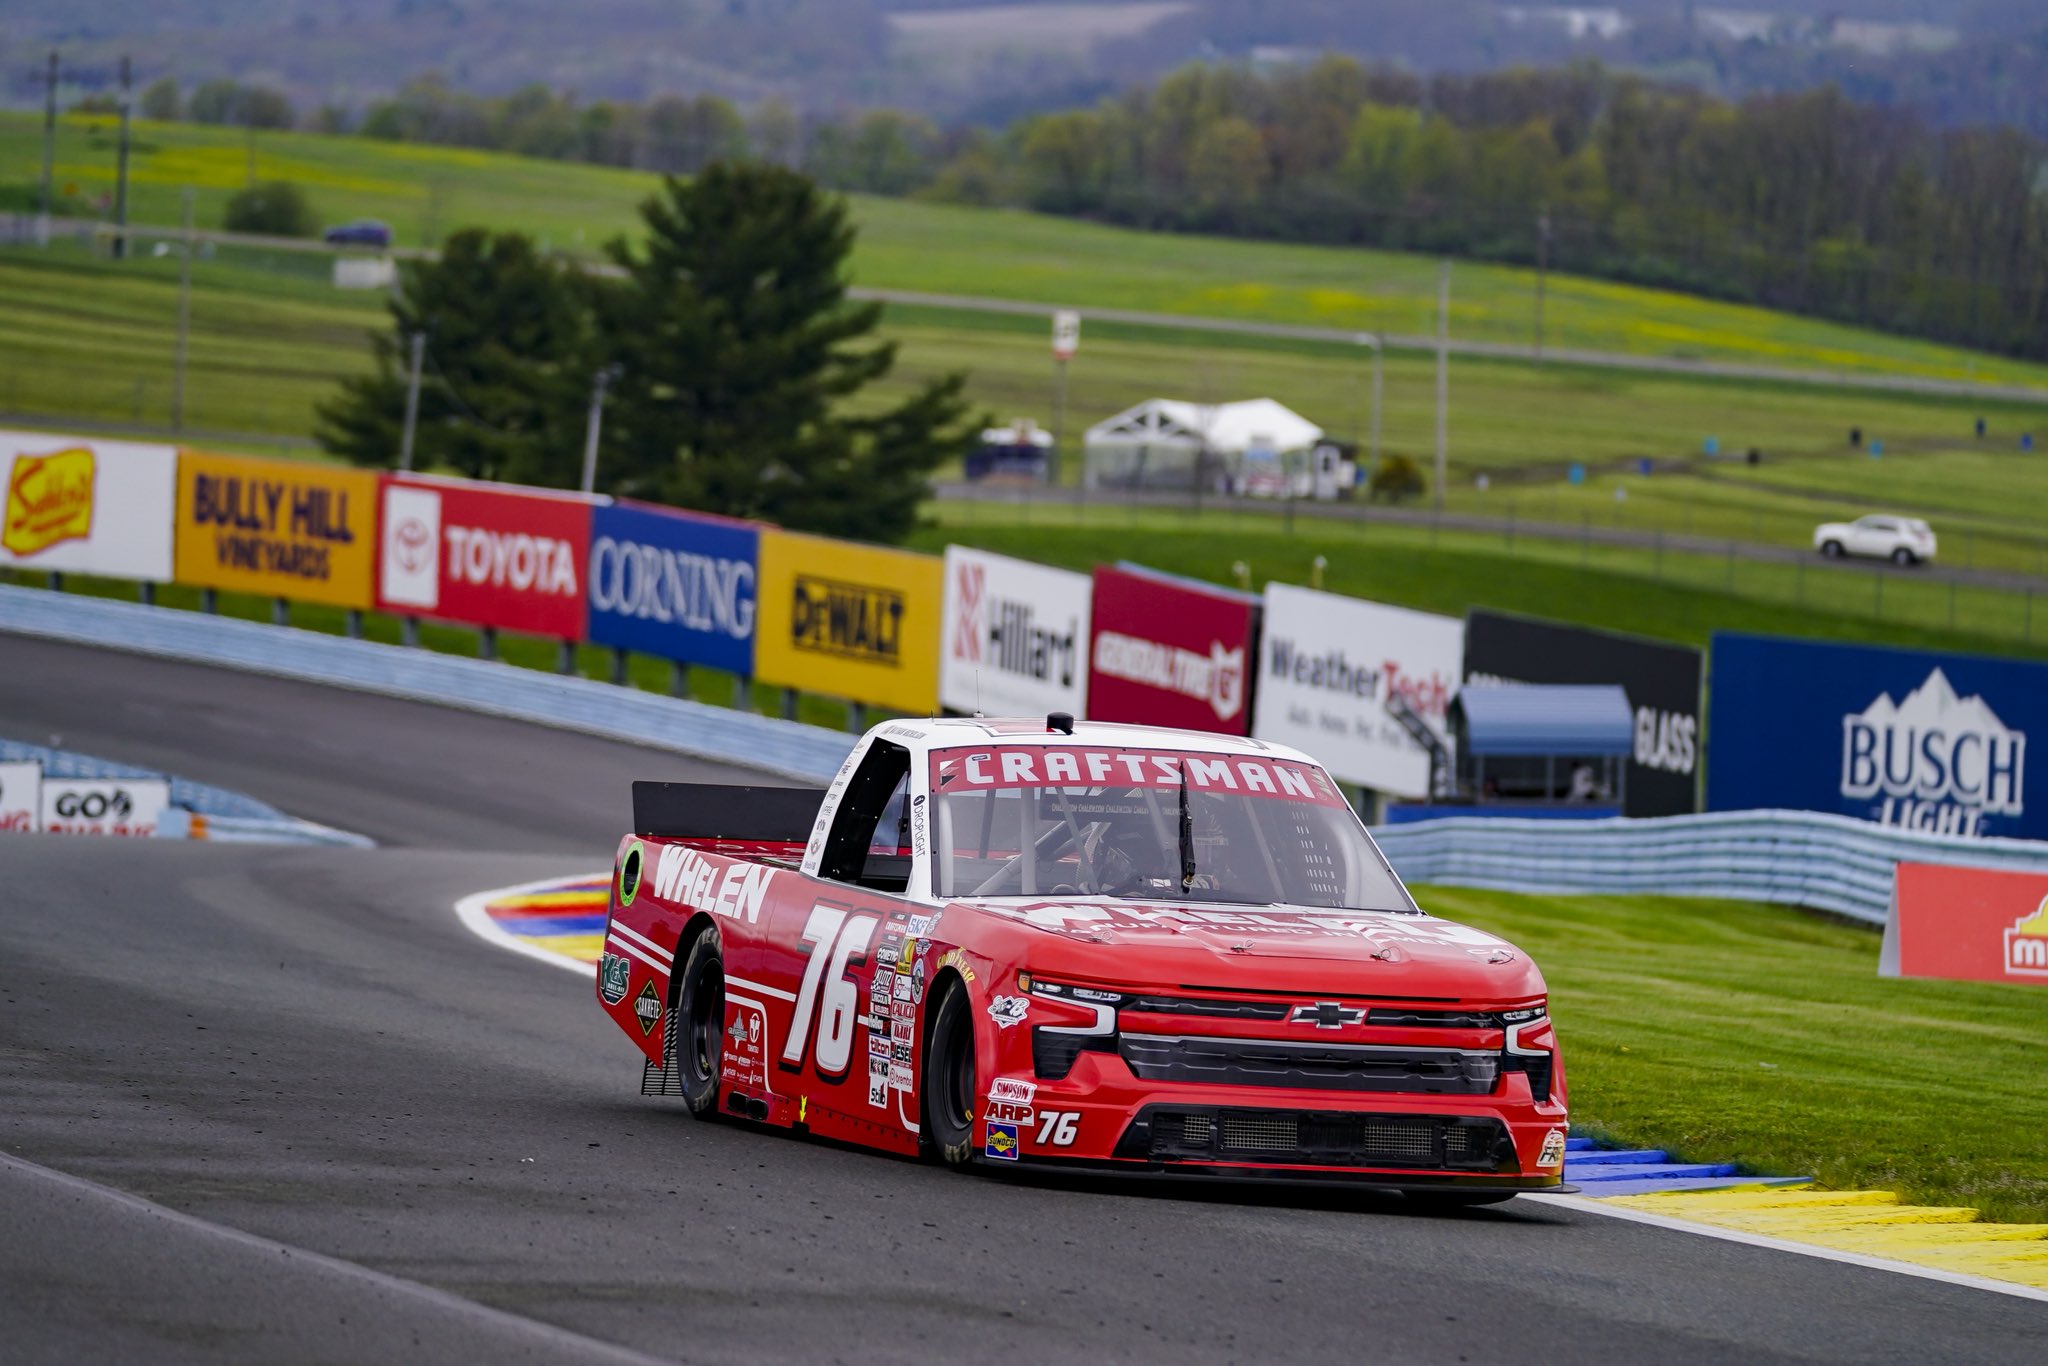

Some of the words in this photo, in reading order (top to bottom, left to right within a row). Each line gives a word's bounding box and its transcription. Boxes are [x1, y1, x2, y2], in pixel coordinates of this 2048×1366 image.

[194, 470, 284, 533] BULLY
[290, 485, 354, 545] HILL
[446, 525, 577, 596] TOYOTA
[590, 536, 755, 640] CORNING
[1634, 705, 1696, 775] GLASS
[965, 752, 1315, 798] CRAFTSMAN
[1847, 720, 2021, 808] BUSCH
[1881, 798, 1981, 840] LIGHT
[655, 844, 777, 924] WHELEN
[908, 918, 929, 934] SKF
[1372, 935, 1515, 956] AMERCA
[781, 904, 880, 1073] 76
[987, 1101, 1033, 1122] ARP
[996, 1082, 1030, 1100] SIMPSON
[988, 1136, 1016, 1148] SUNOCO
[1036, 1111, 1080, 1146] 76
